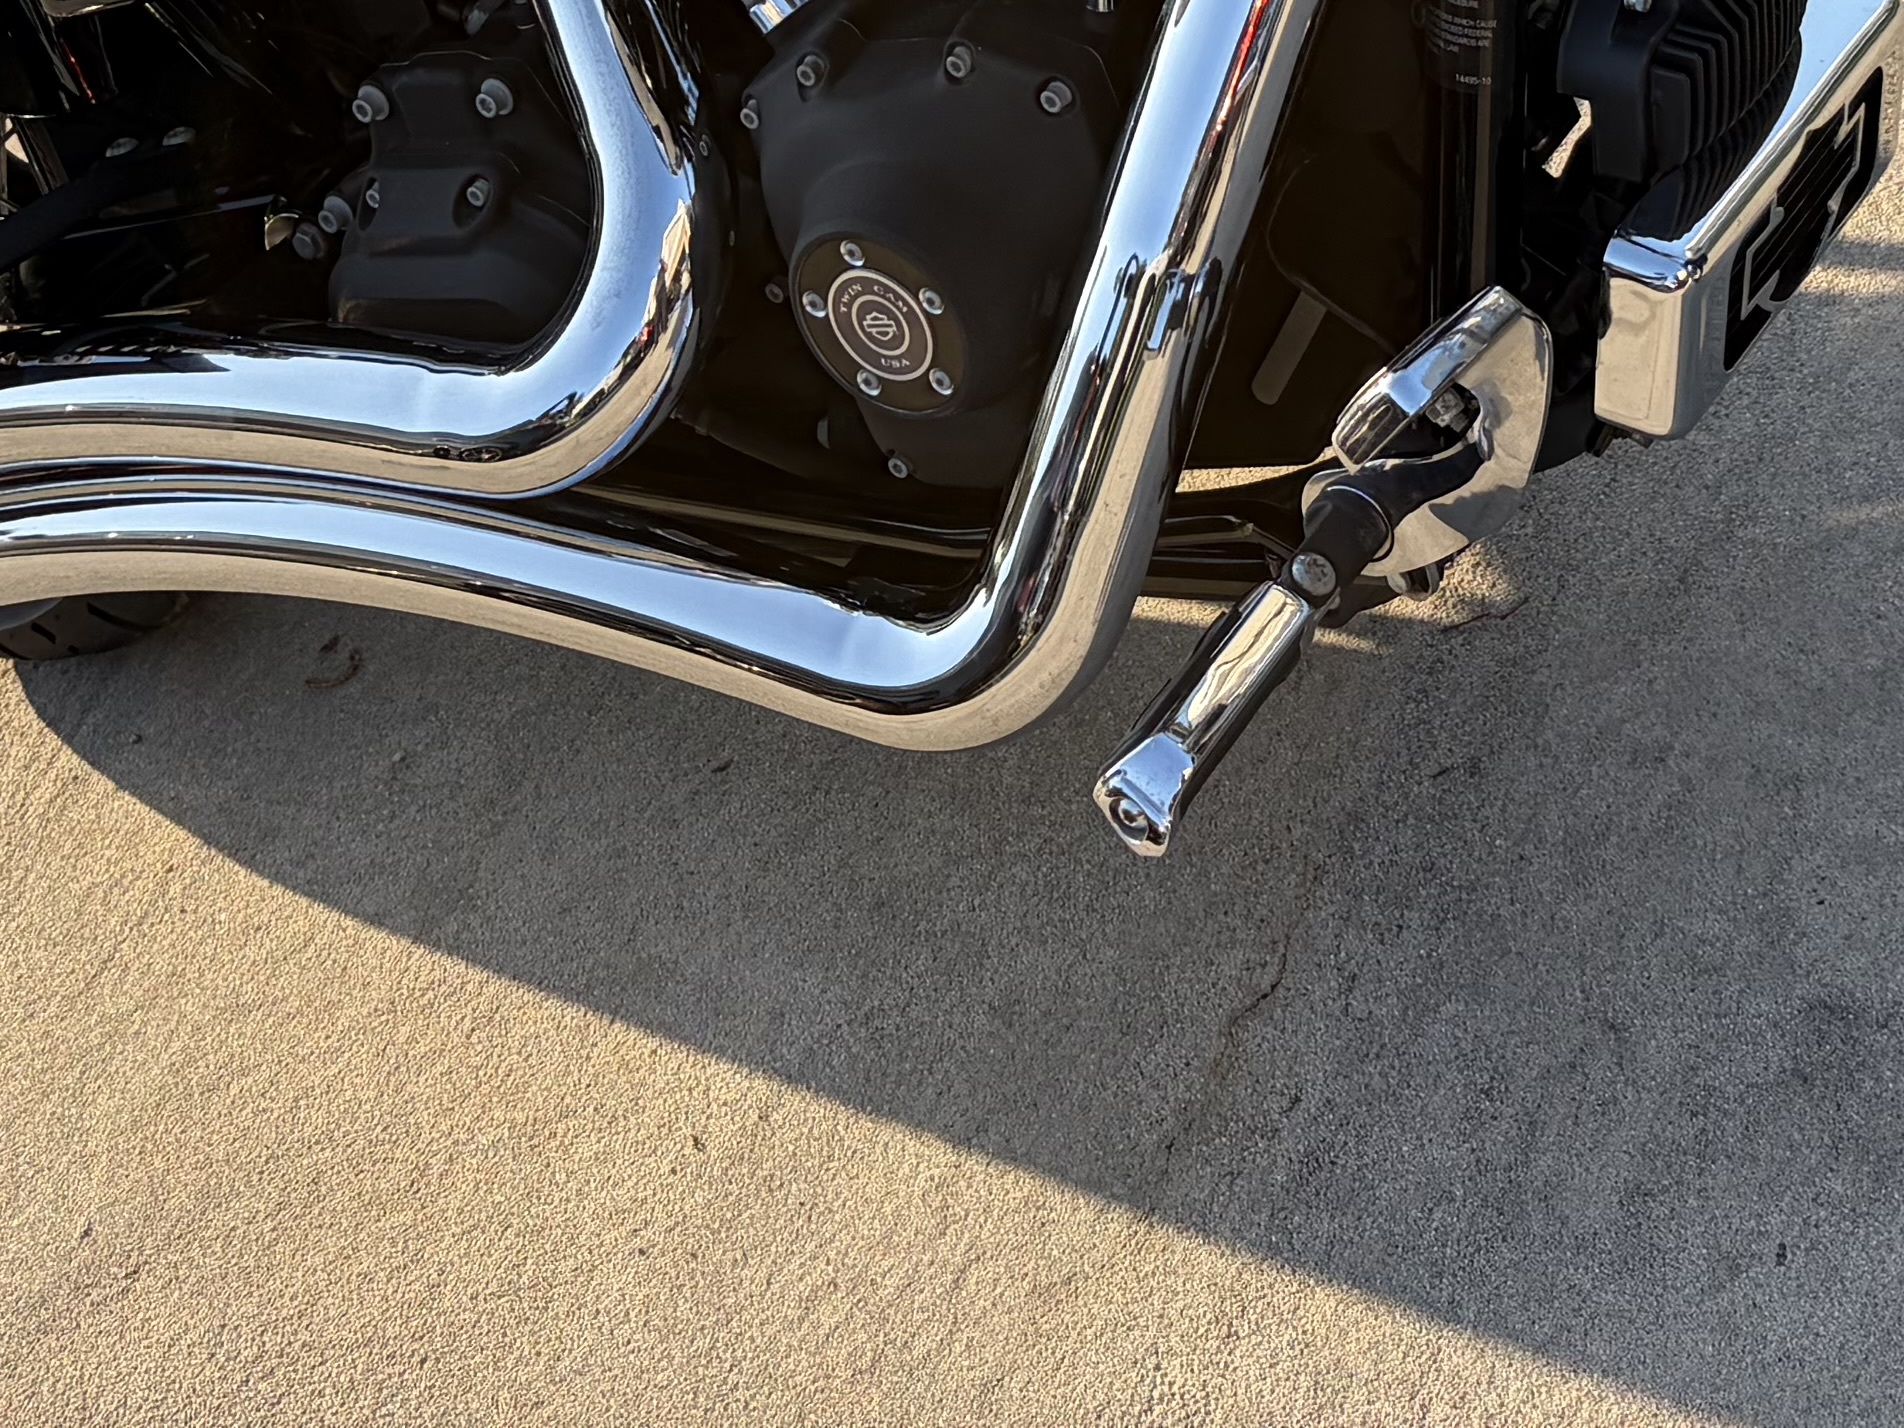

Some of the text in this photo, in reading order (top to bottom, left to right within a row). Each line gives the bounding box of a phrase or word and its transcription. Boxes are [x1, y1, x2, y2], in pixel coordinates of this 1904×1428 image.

[839, 283, 909, 315] TWIN CAM
[880, 356, 911, 369] USA
